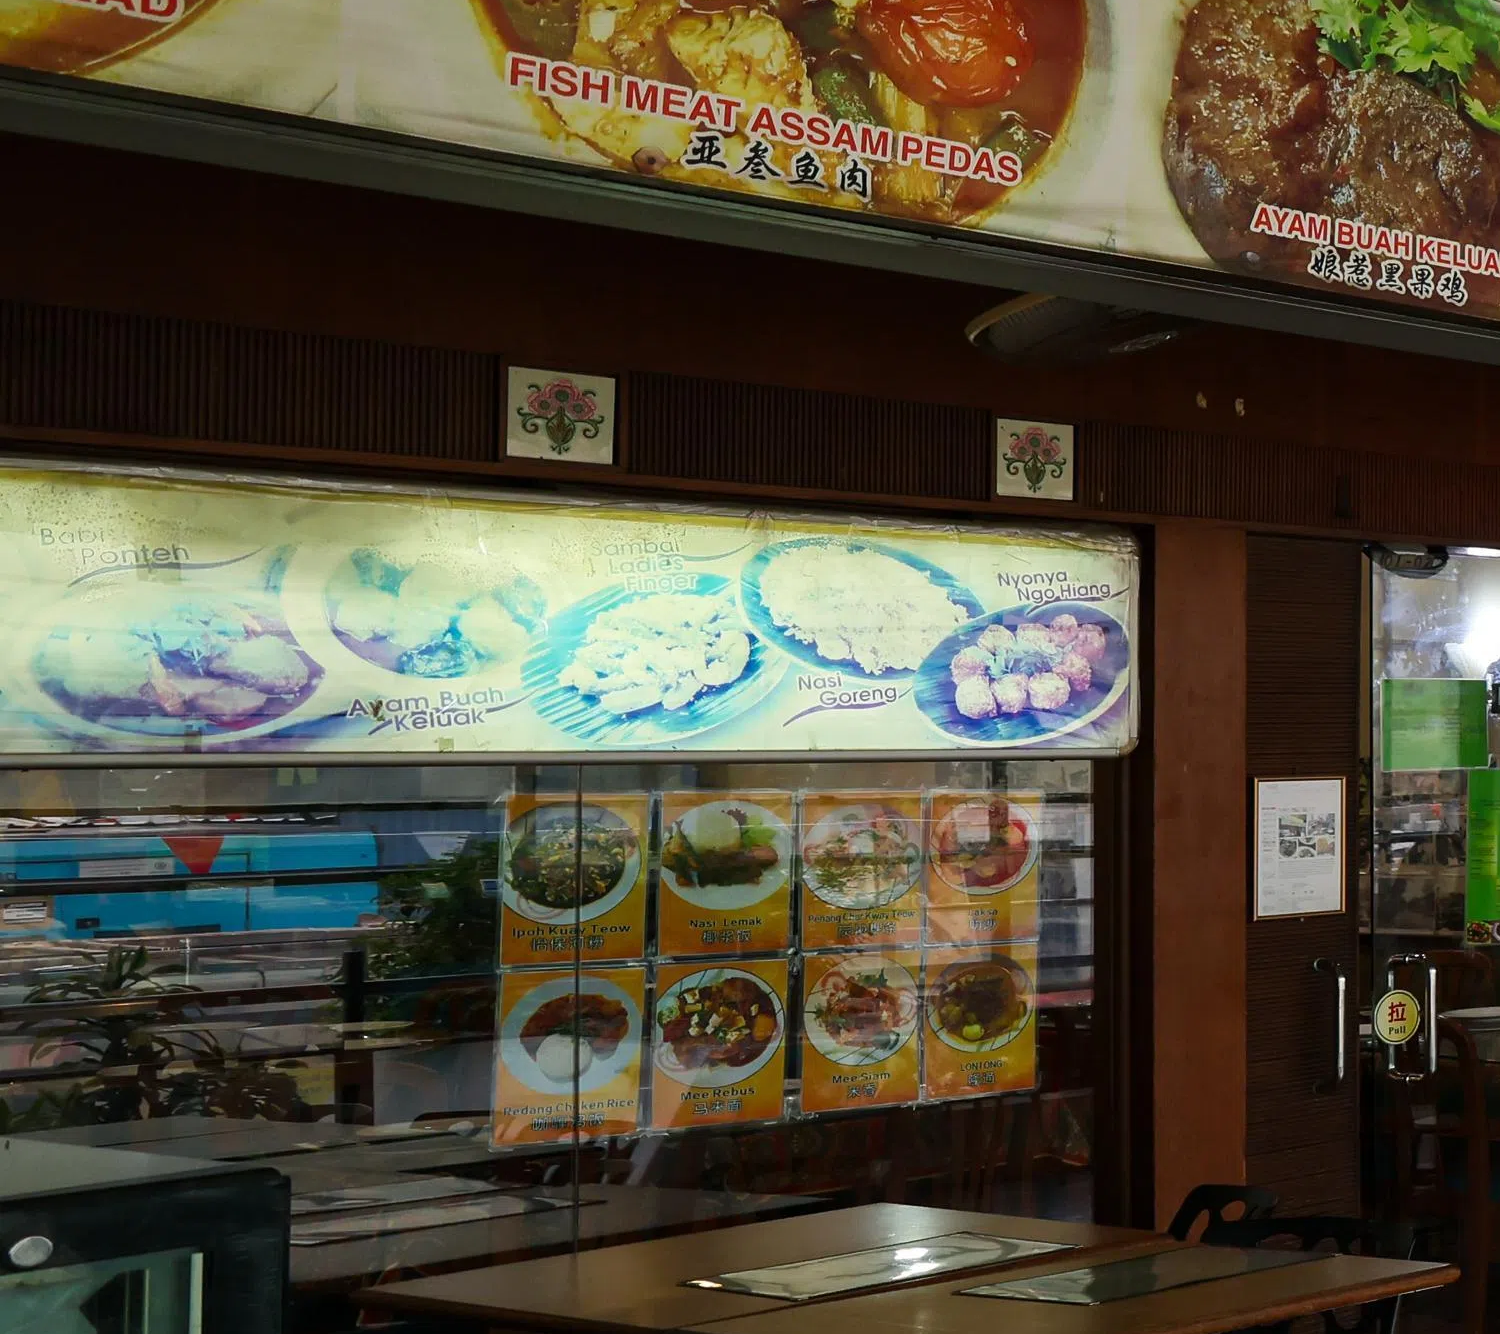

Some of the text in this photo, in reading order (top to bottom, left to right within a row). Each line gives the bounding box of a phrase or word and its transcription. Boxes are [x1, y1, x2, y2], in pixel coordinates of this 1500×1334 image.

[507, 53, 1022, 185] FISH MEAT ASSAM PEDAS
[1252, 203, 1328, 245] AYAM
[1335, 218, 1412, 261] BUAH
[1309, 247, 1468, 307] 娘惹黑果鸡
[81, 544, 189, 565] Ponteh
[592, 539, 680, 557] Sambal
[609, 556, 684, 575] Ladies
[625, 574, 697, 593] Finger
[998, 570, 1068, 590] Nyonya
[1017, 583, 1110, 604] Ngo Hiang
[797, 674, 842, 692] Nasi
[348, 686, 504, 721] Ayam Buah
[819, 686, 897, 708] Goreng
[393, 708, 485, 732] Keluak
[689, 917, 762, 929] Nasi Lemak
[808, 913, 842, 924] Penang
[512, 926, 545, 939] Ipoh
[591, 923, 631, 934] Teow
[1388, 1001, 1407, 1023] 拉
[1389, 1026, 1406, 1035] Pull
[832, 1071, 891, 1084] Mee Siam
[607, 1098, 635, 1108] Rice
[680, 1086, 755, 1101] Mee Rebus
